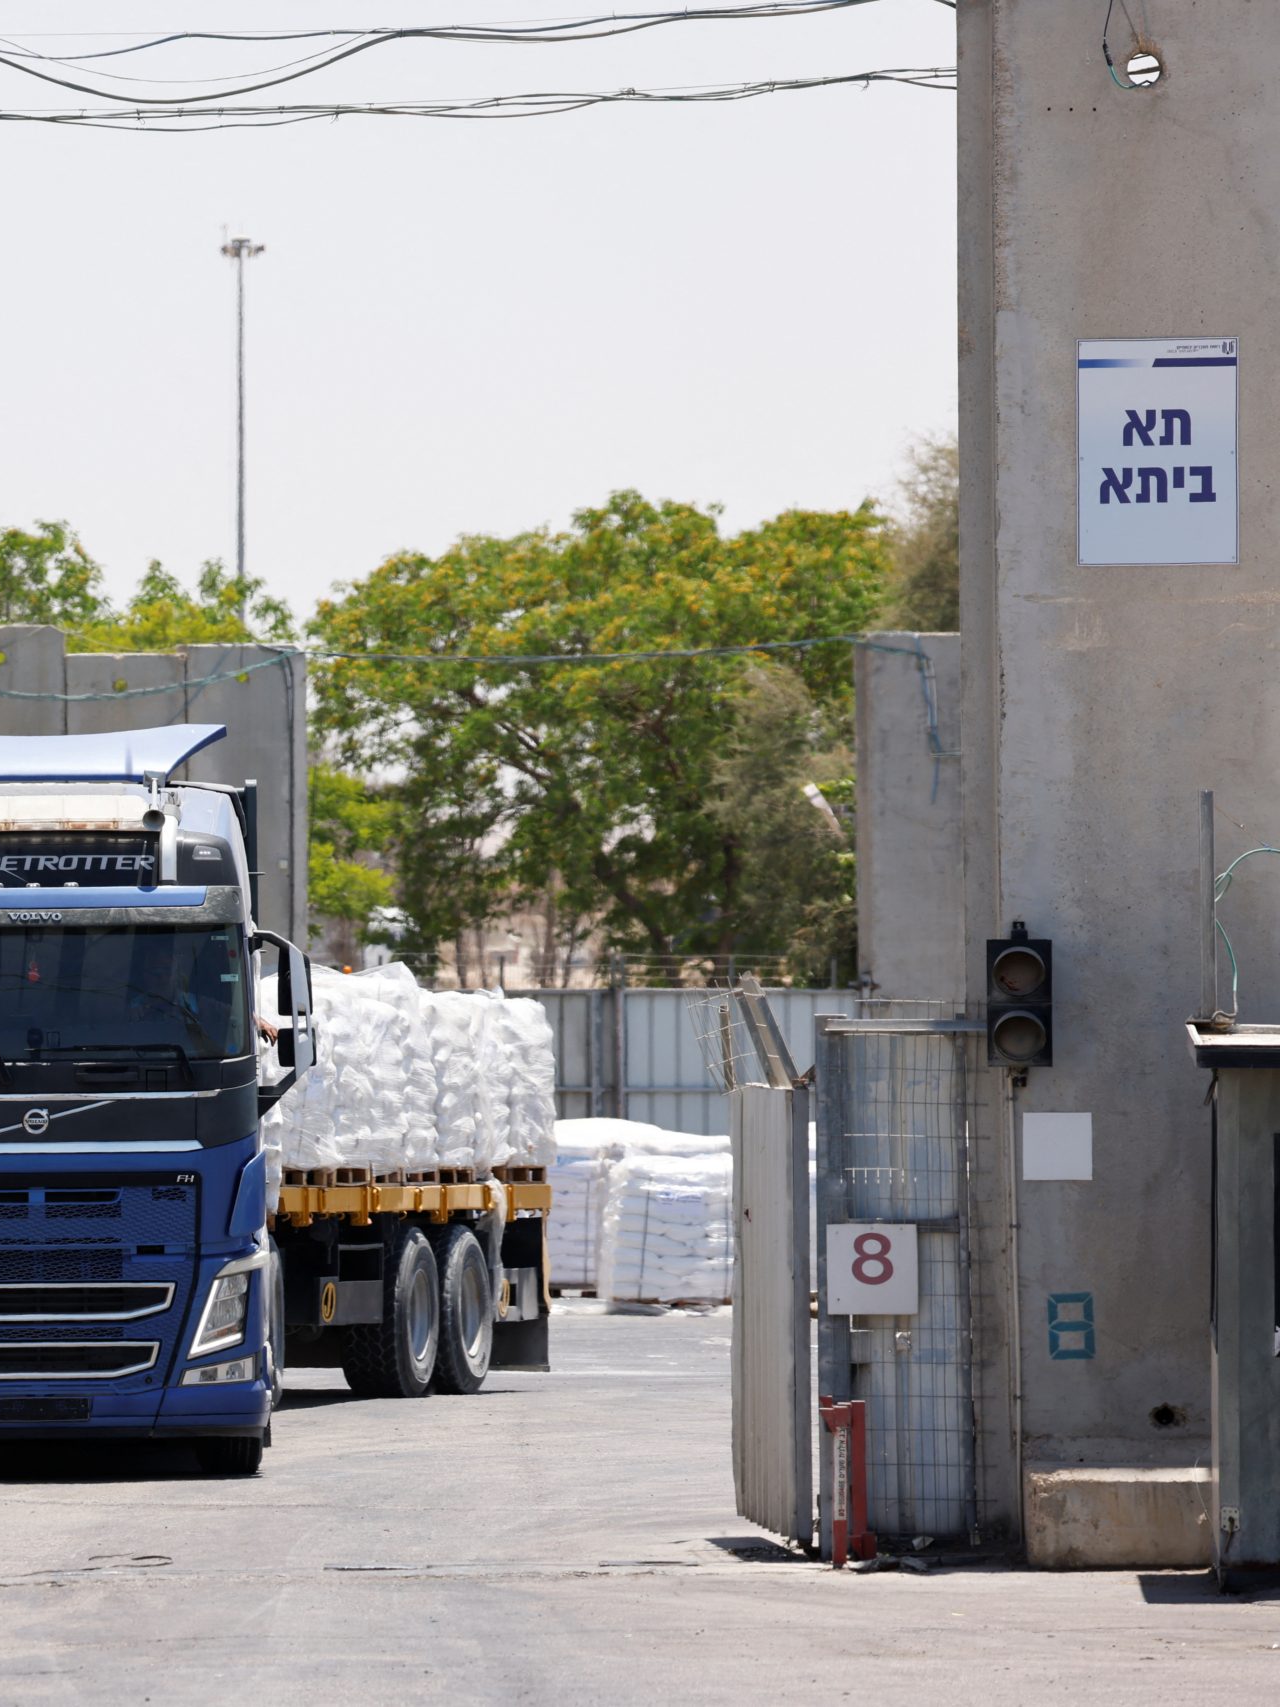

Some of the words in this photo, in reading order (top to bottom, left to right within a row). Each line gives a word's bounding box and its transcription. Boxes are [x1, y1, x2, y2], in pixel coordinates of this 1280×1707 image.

[1122, 408, 1192, 447] תא
[1099, 465, 1217, 505] ביתא
[8, 911, 63, 923] VOLVO
[176, 1174, 195, 1183] FH
[851, 1232, 894, 1286] 8
[1048, 1292, 1095, 1360] 8
